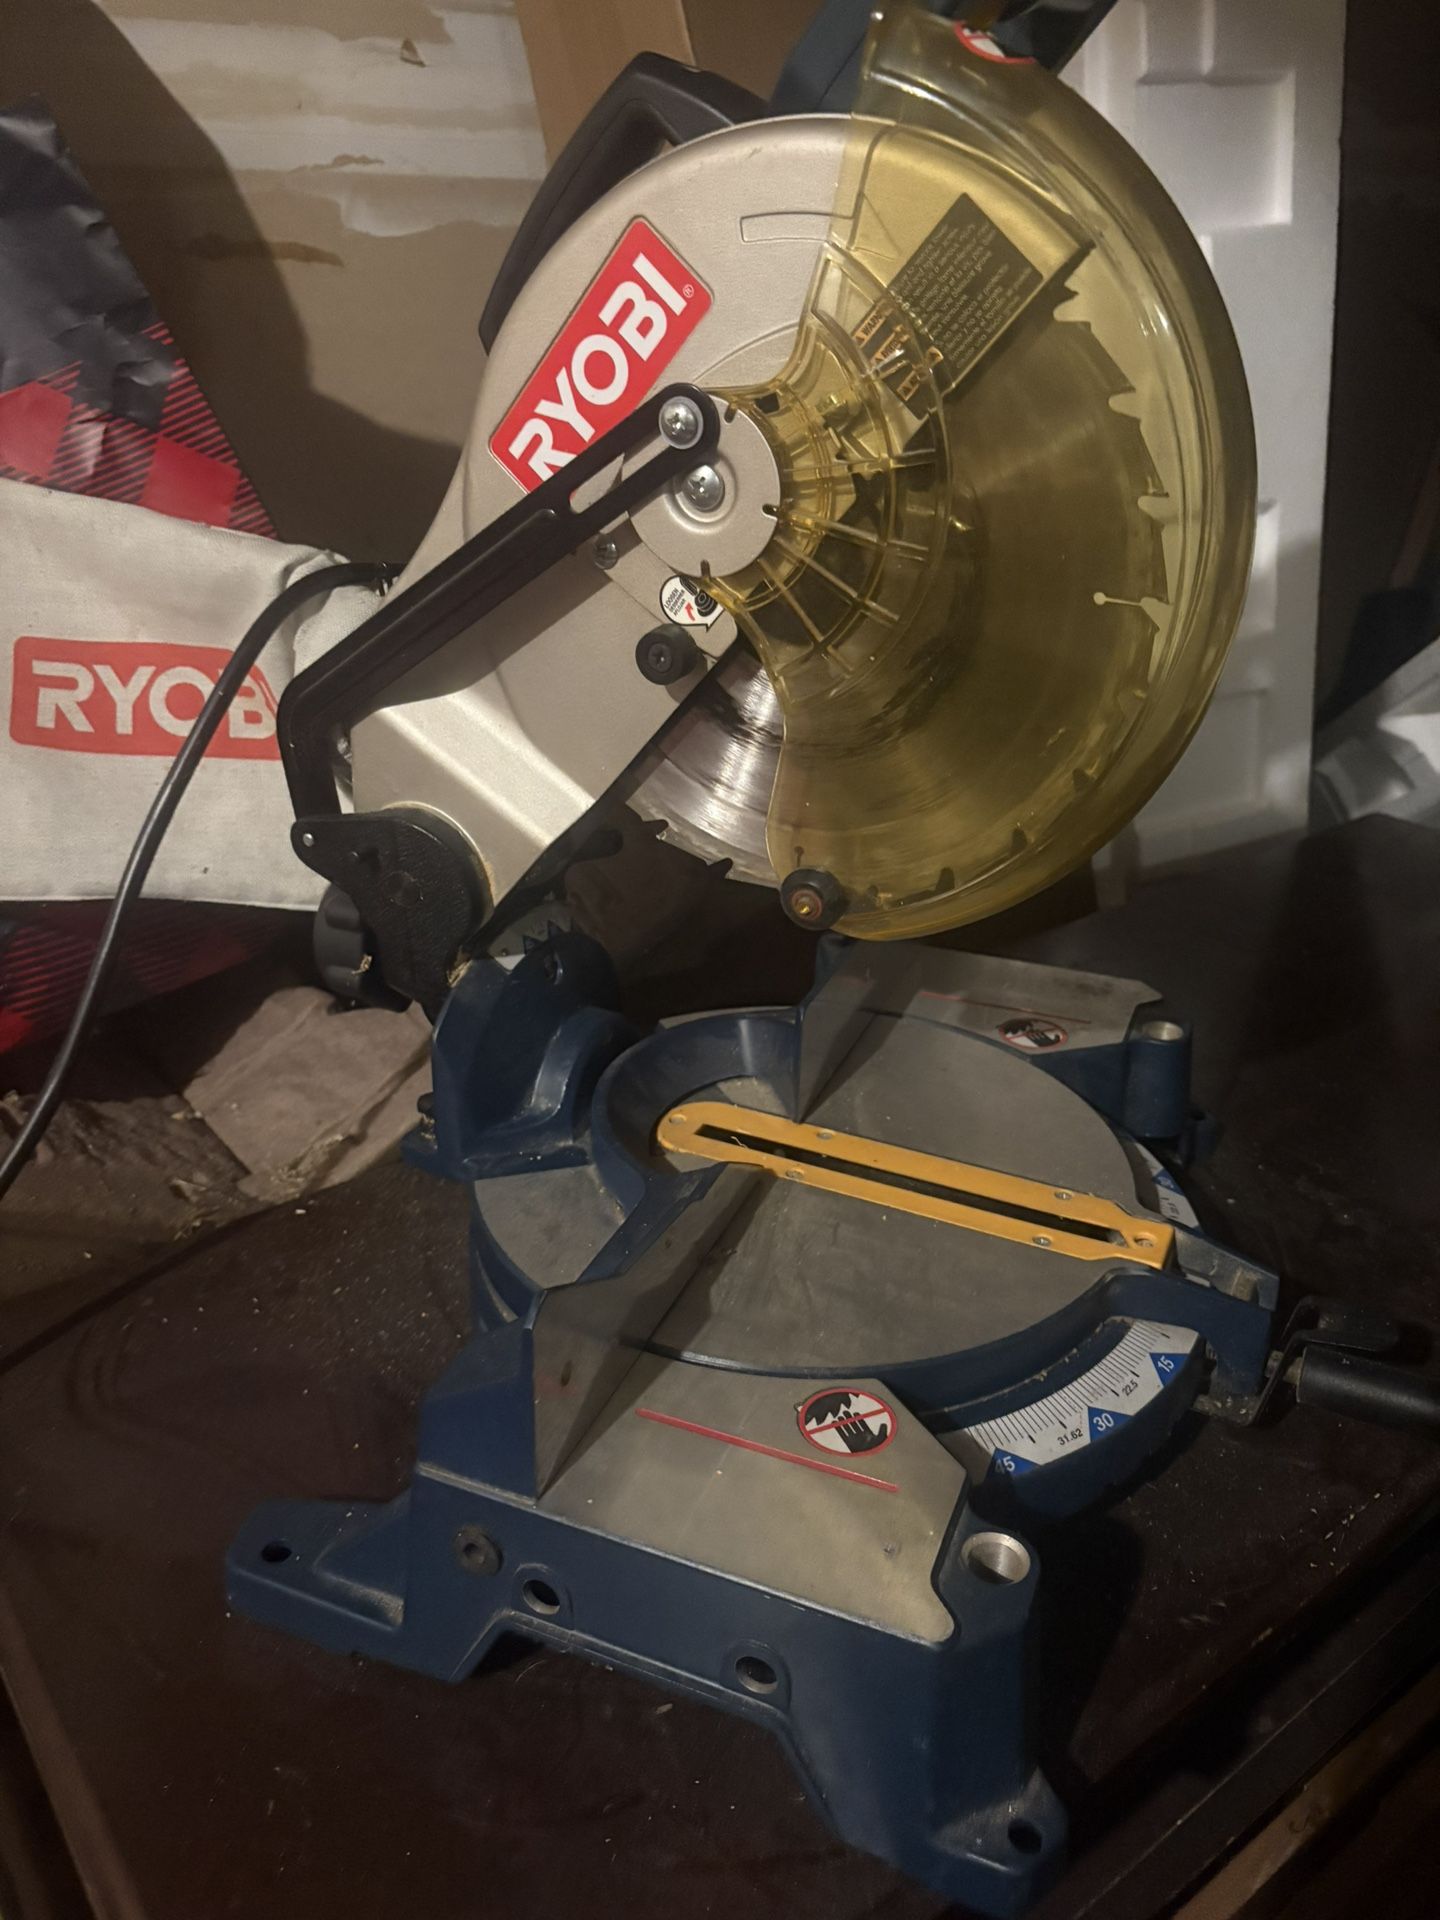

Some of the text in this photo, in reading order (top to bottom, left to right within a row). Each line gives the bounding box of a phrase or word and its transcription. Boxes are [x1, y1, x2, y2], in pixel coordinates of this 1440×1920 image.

[508, 252, 687, 482] RYOBI
[31, 659, 277, 740] RYOB
[1157, 1354, 1174, 1373] 15
[1121, 1378, 1139, 1397] 22.5
[1093, 1412, 1115, 1432] 30
[1057, 1427, 1084, 1446] 31.62
